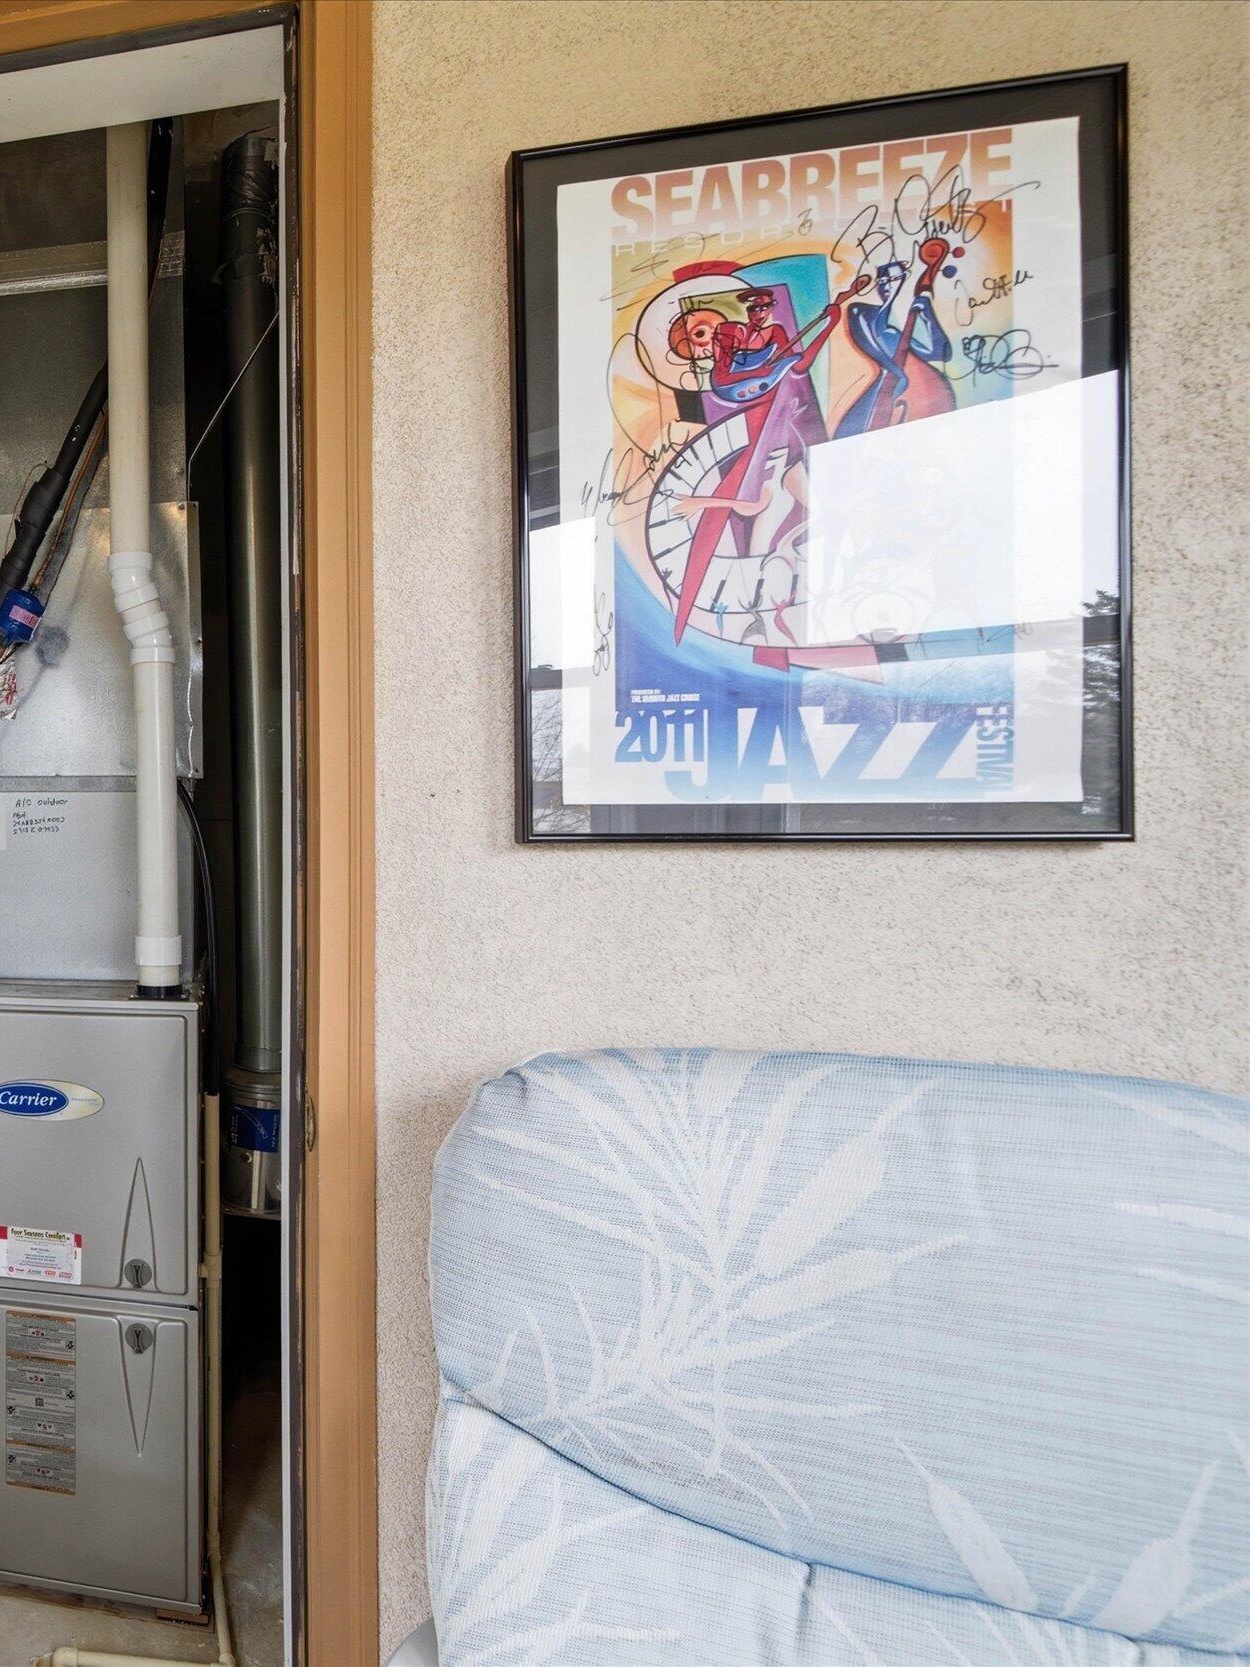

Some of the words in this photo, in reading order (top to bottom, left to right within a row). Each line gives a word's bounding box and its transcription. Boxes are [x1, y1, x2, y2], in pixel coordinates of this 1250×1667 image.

[611, 128, 1013, 242] SEABREEZE
[614, 707, 706, 763] 2011
[664, 705, 986, 800] JAZZ
[15, 799, 32, 807] A/C
